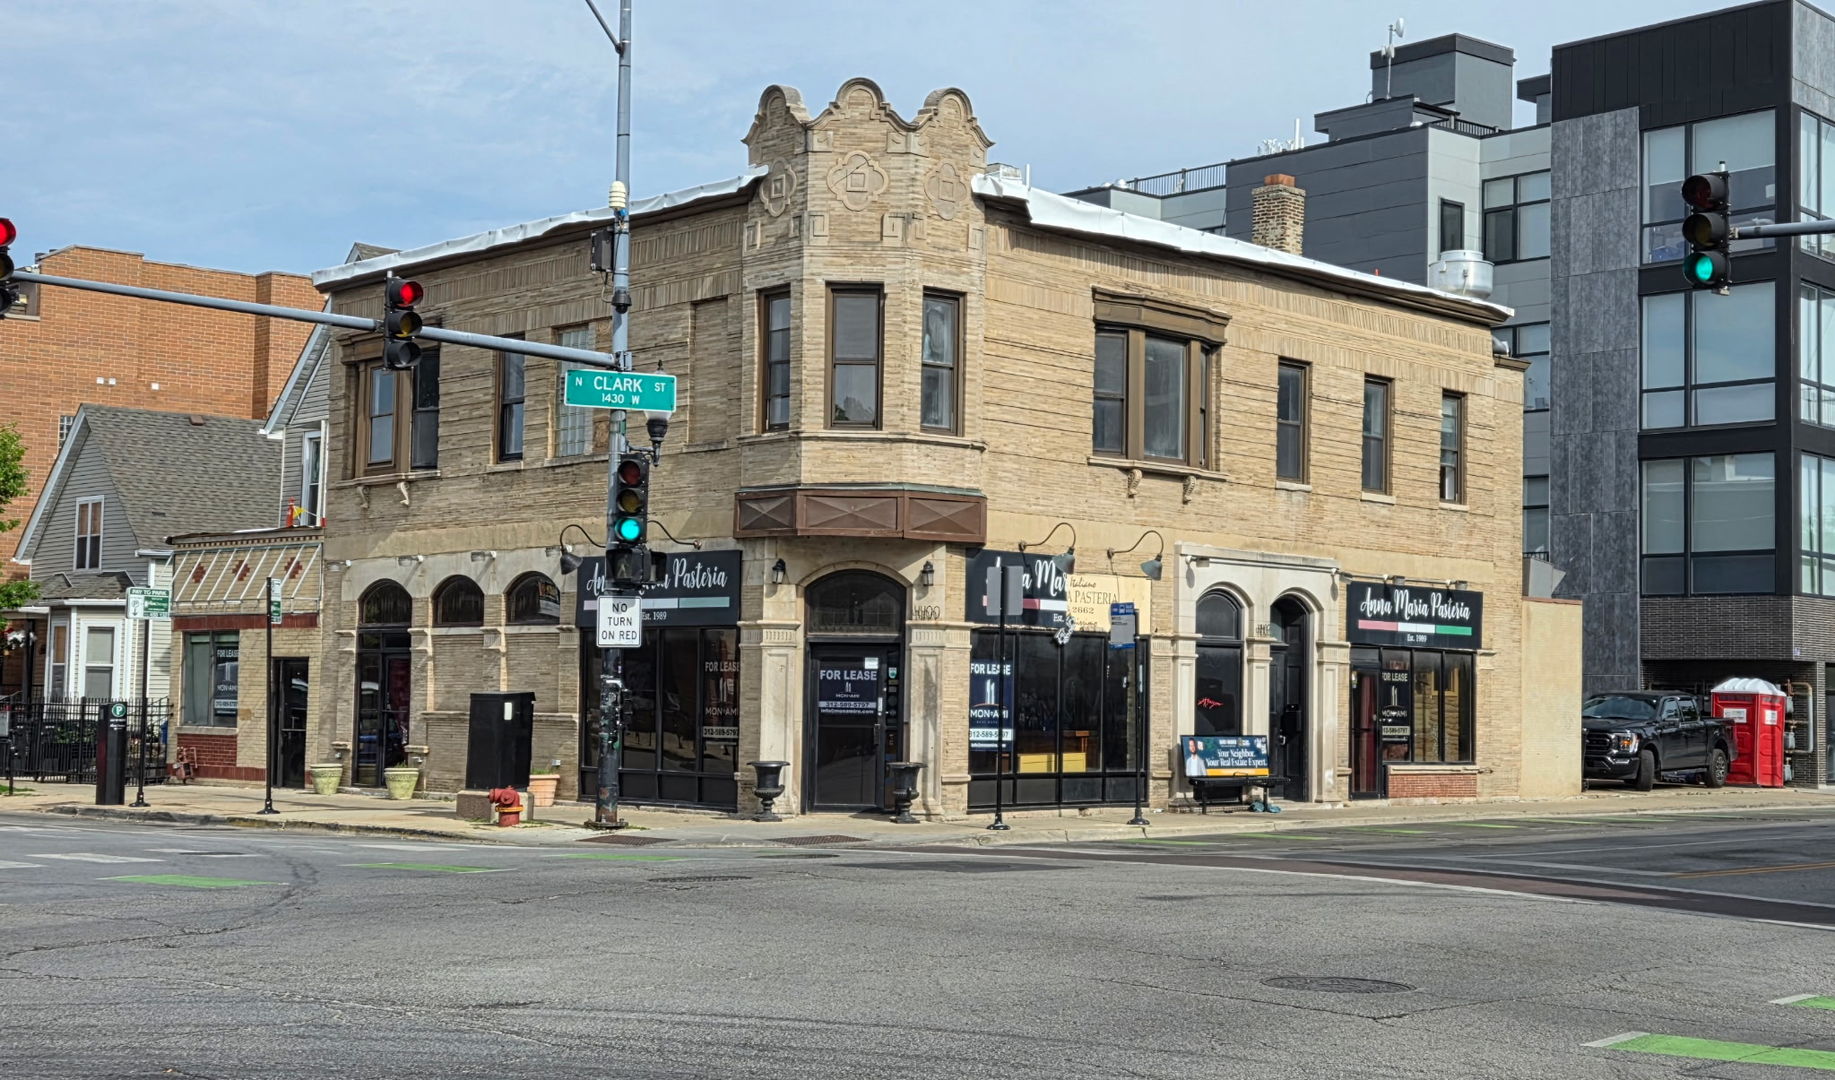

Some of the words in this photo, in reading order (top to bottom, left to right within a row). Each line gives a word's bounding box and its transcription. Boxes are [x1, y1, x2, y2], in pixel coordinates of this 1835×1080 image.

[575, 377, 583, 386] N
[593, 376, 643, 393] CLARK
[654, 382, 666, 392] ST
[601, 393, 625, 404] 1430
[631, 395, 640, 405] W
[672, 557, 728, 589] Pasteria
[1034, 559, 1068, 597] Mar
[1074, 590, 1118, 605] PASTERIA
[612, 603, 628, 613] NO
[1360, 586, 1392, 618] Anna
[1393, 589, 1430, 621] Maria
[1430, 592, 1471, 620] Pasteria
[607, 616, 633, 627] TURN
[653, 612, 667, 621] 1989
[601, 630, 615, 640] ON
[619, 631, 638, 640] RED
[1407, 634, 1415, 642] Est.
[705, 661, 719, 672] FOR
[970, 662, 985, 675] FOR
[986, 663, 1011, 676] LEAE
[820, 670, 841, 681] FOR
[843, 670, 877, 681] LEASE
[1392, 672, 1408, 682] LEASE
